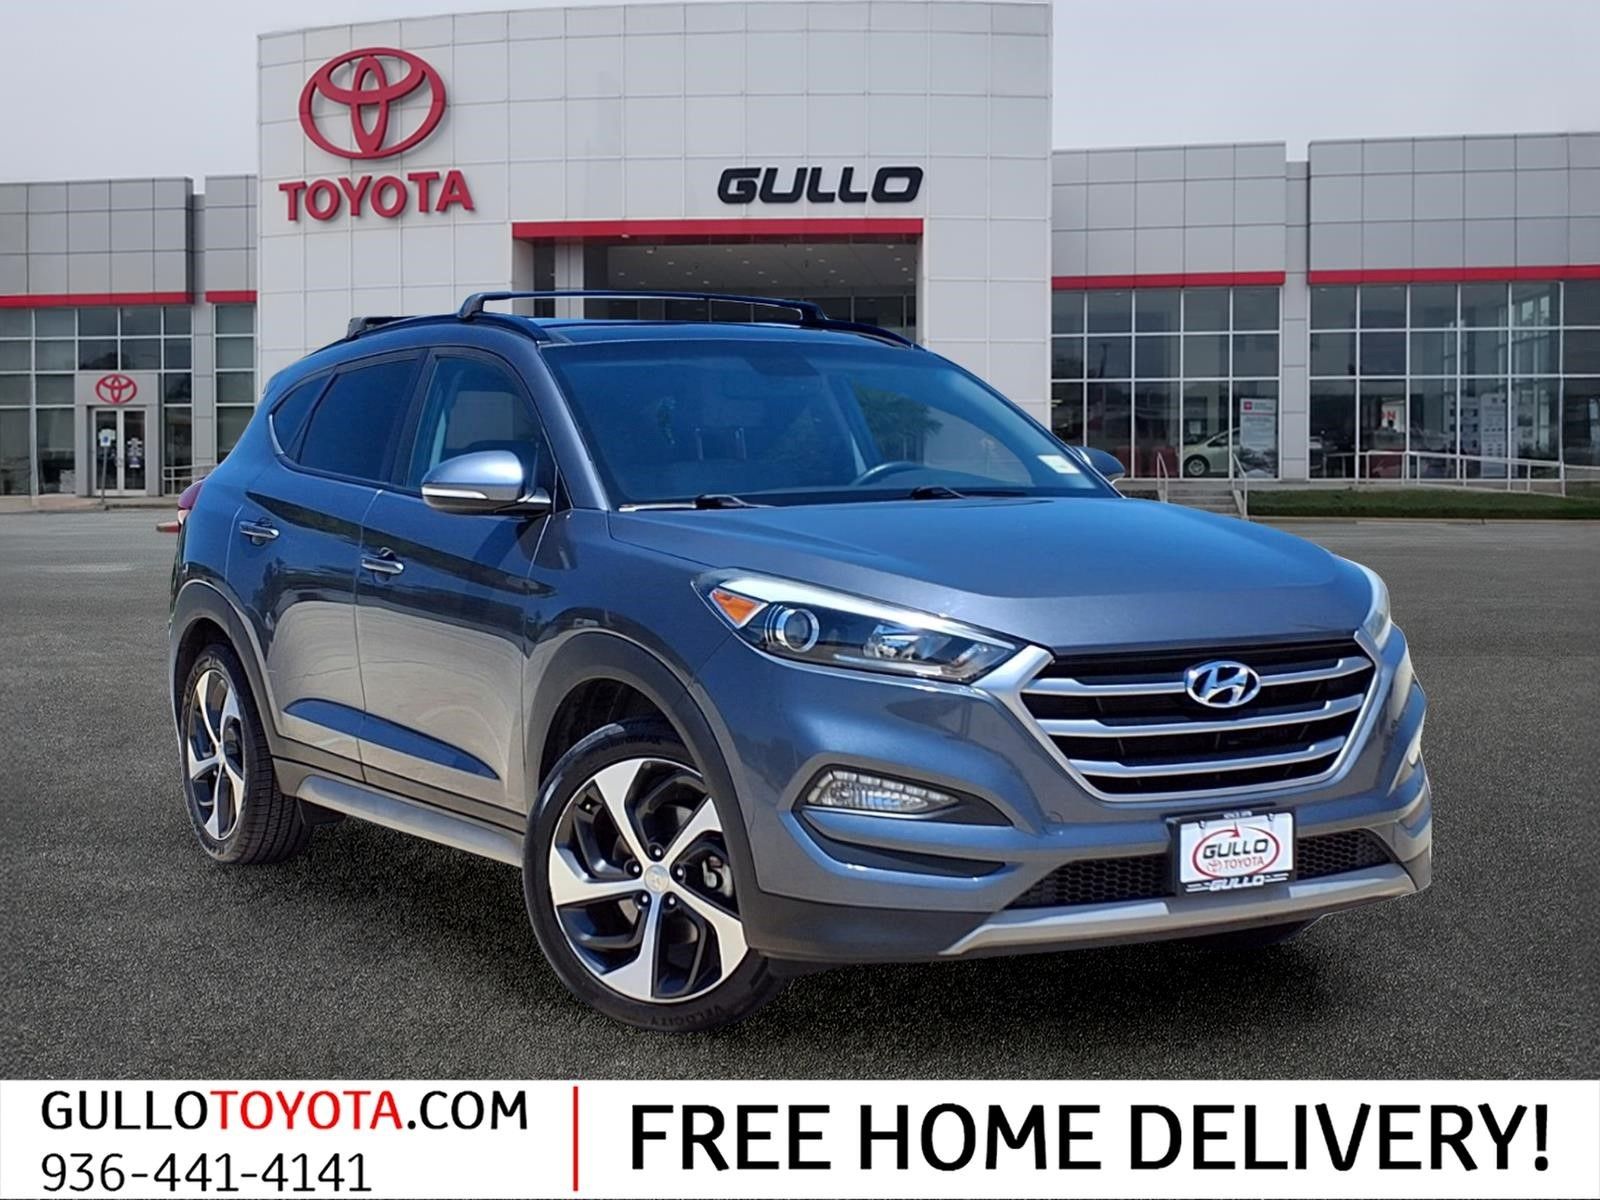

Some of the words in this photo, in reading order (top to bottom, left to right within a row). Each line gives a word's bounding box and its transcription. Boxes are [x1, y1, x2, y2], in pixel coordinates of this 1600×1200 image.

[279, 170, 475, 222] TOYOTA
[716, 166, 924, 205] GULLO
[1203, 838, 1269, 859] GULLO
[1223, 856, 1265, 870] TOYOTA
[1208, 874, 1265, 892] GULLO
